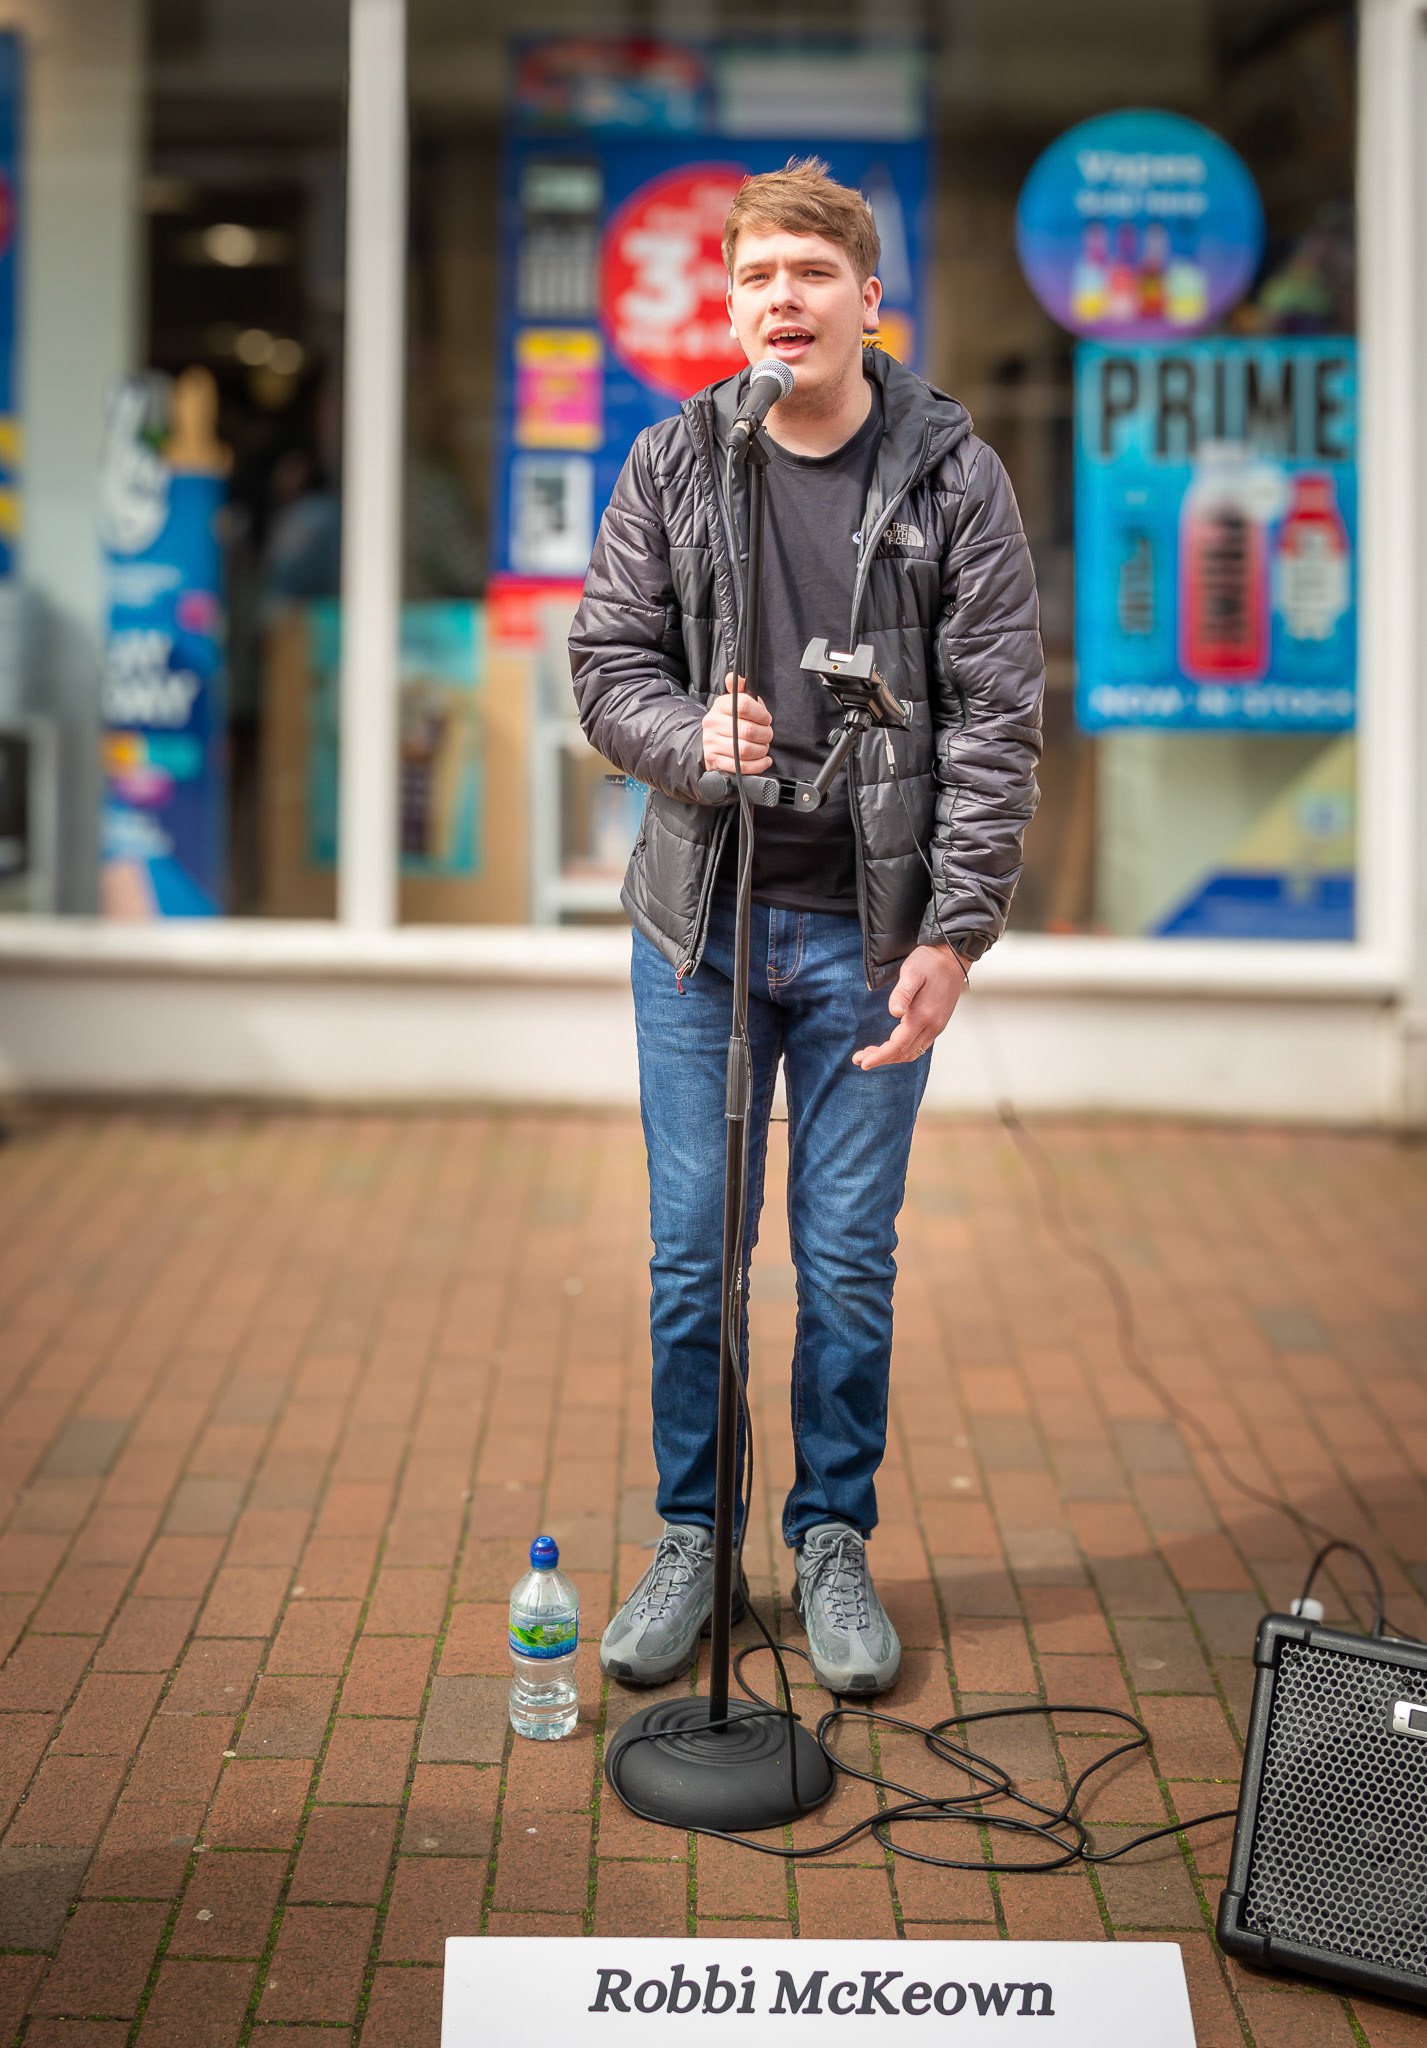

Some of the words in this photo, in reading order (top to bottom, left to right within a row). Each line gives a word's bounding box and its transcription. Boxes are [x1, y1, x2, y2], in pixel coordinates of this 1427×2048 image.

[619, 229, 694, 321] 3
[1101, 357, 1347, 460] PRIME
[892, 522, 909, 531] THE
[588, 1964, 755, 2013] Robbi
[769, 1971, 1055, 2016] McKeown
